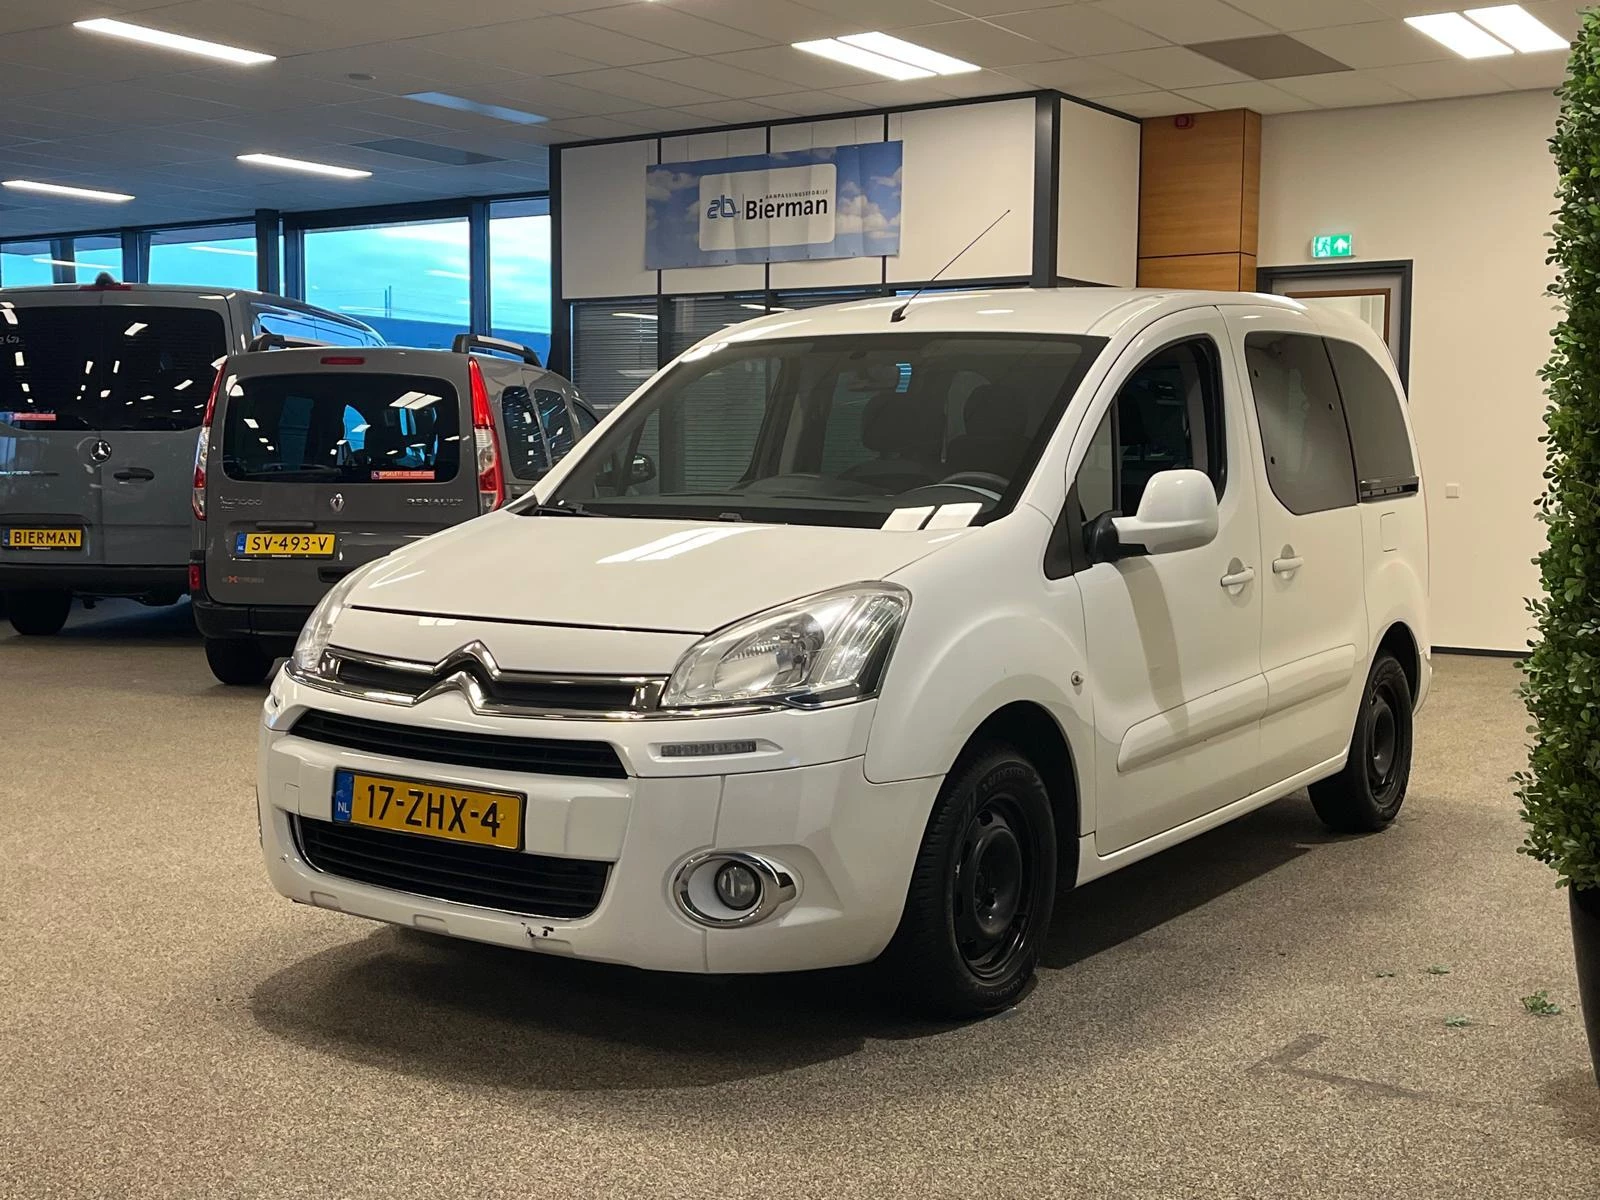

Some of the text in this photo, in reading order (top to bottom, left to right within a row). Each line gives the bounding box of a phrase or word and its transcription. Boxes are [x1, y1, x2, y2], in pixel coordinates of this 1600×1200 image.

[746, 198, 828, 220] Bierman
[14, 531, 77, 544] BIERMAN
[251, 536, 328, 551] SV-493-V
[337, 802, 350, 813] NL
[367, 784, 500, 838] 17-ZHX-4
